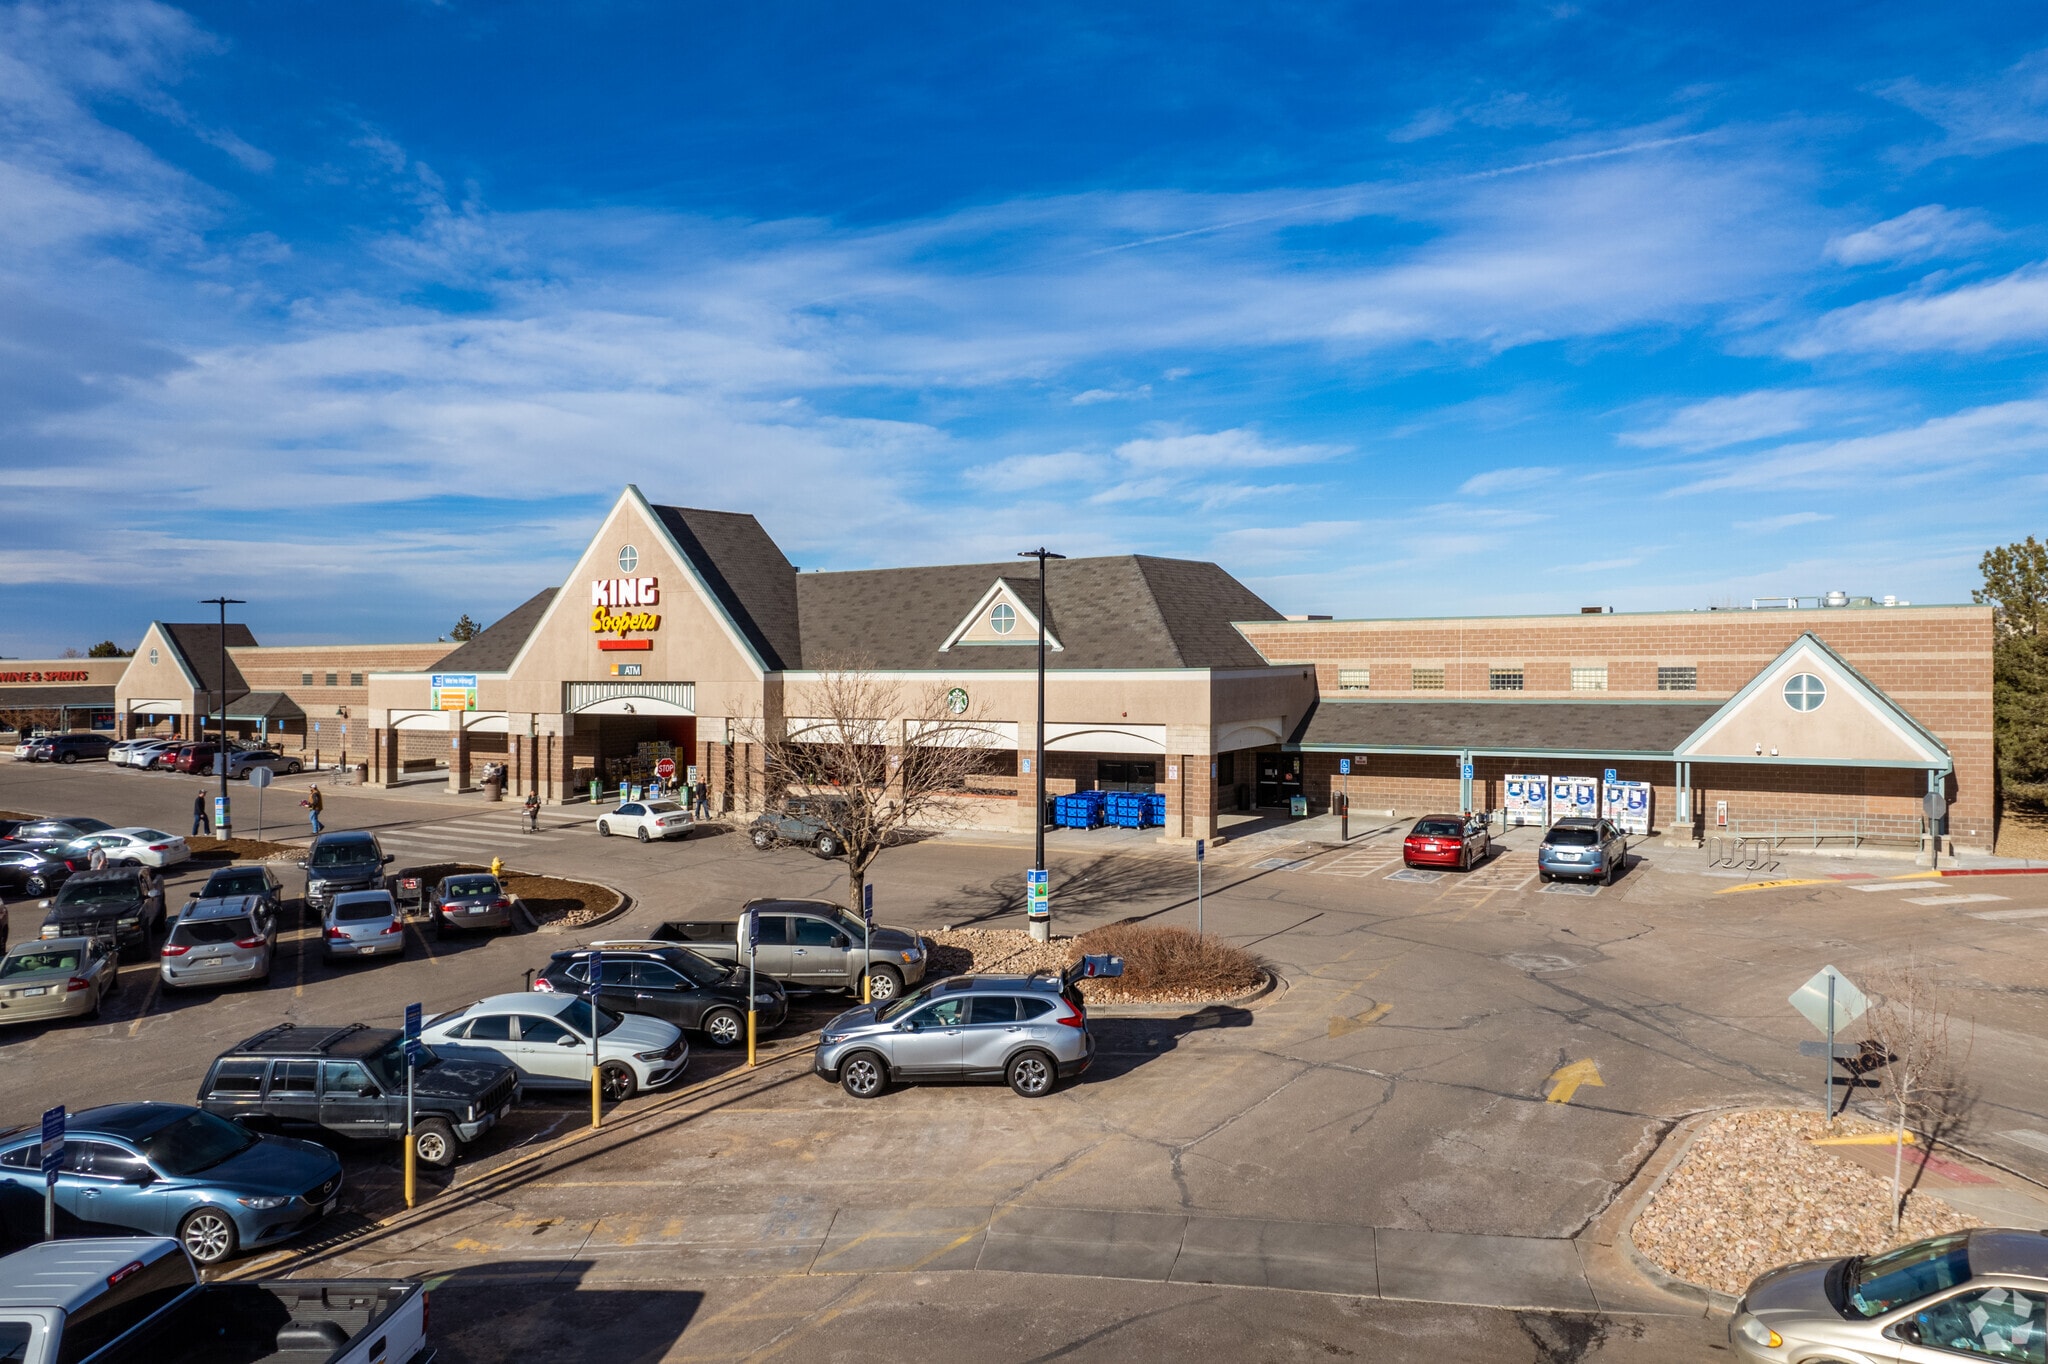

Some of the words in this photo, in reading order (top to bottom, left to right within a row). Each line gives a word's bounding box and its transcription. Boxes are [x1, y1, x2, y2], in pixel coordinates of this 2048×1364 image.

[592, 577, 659, 606] KING
[590, 606, 661, 638] Soopers
[624, 665, 641, 675] ATM
[31, 671, 42, 682] &
[43, 671, 89, 681] SPIRITS
[658, 764, 674, 773] STOP
